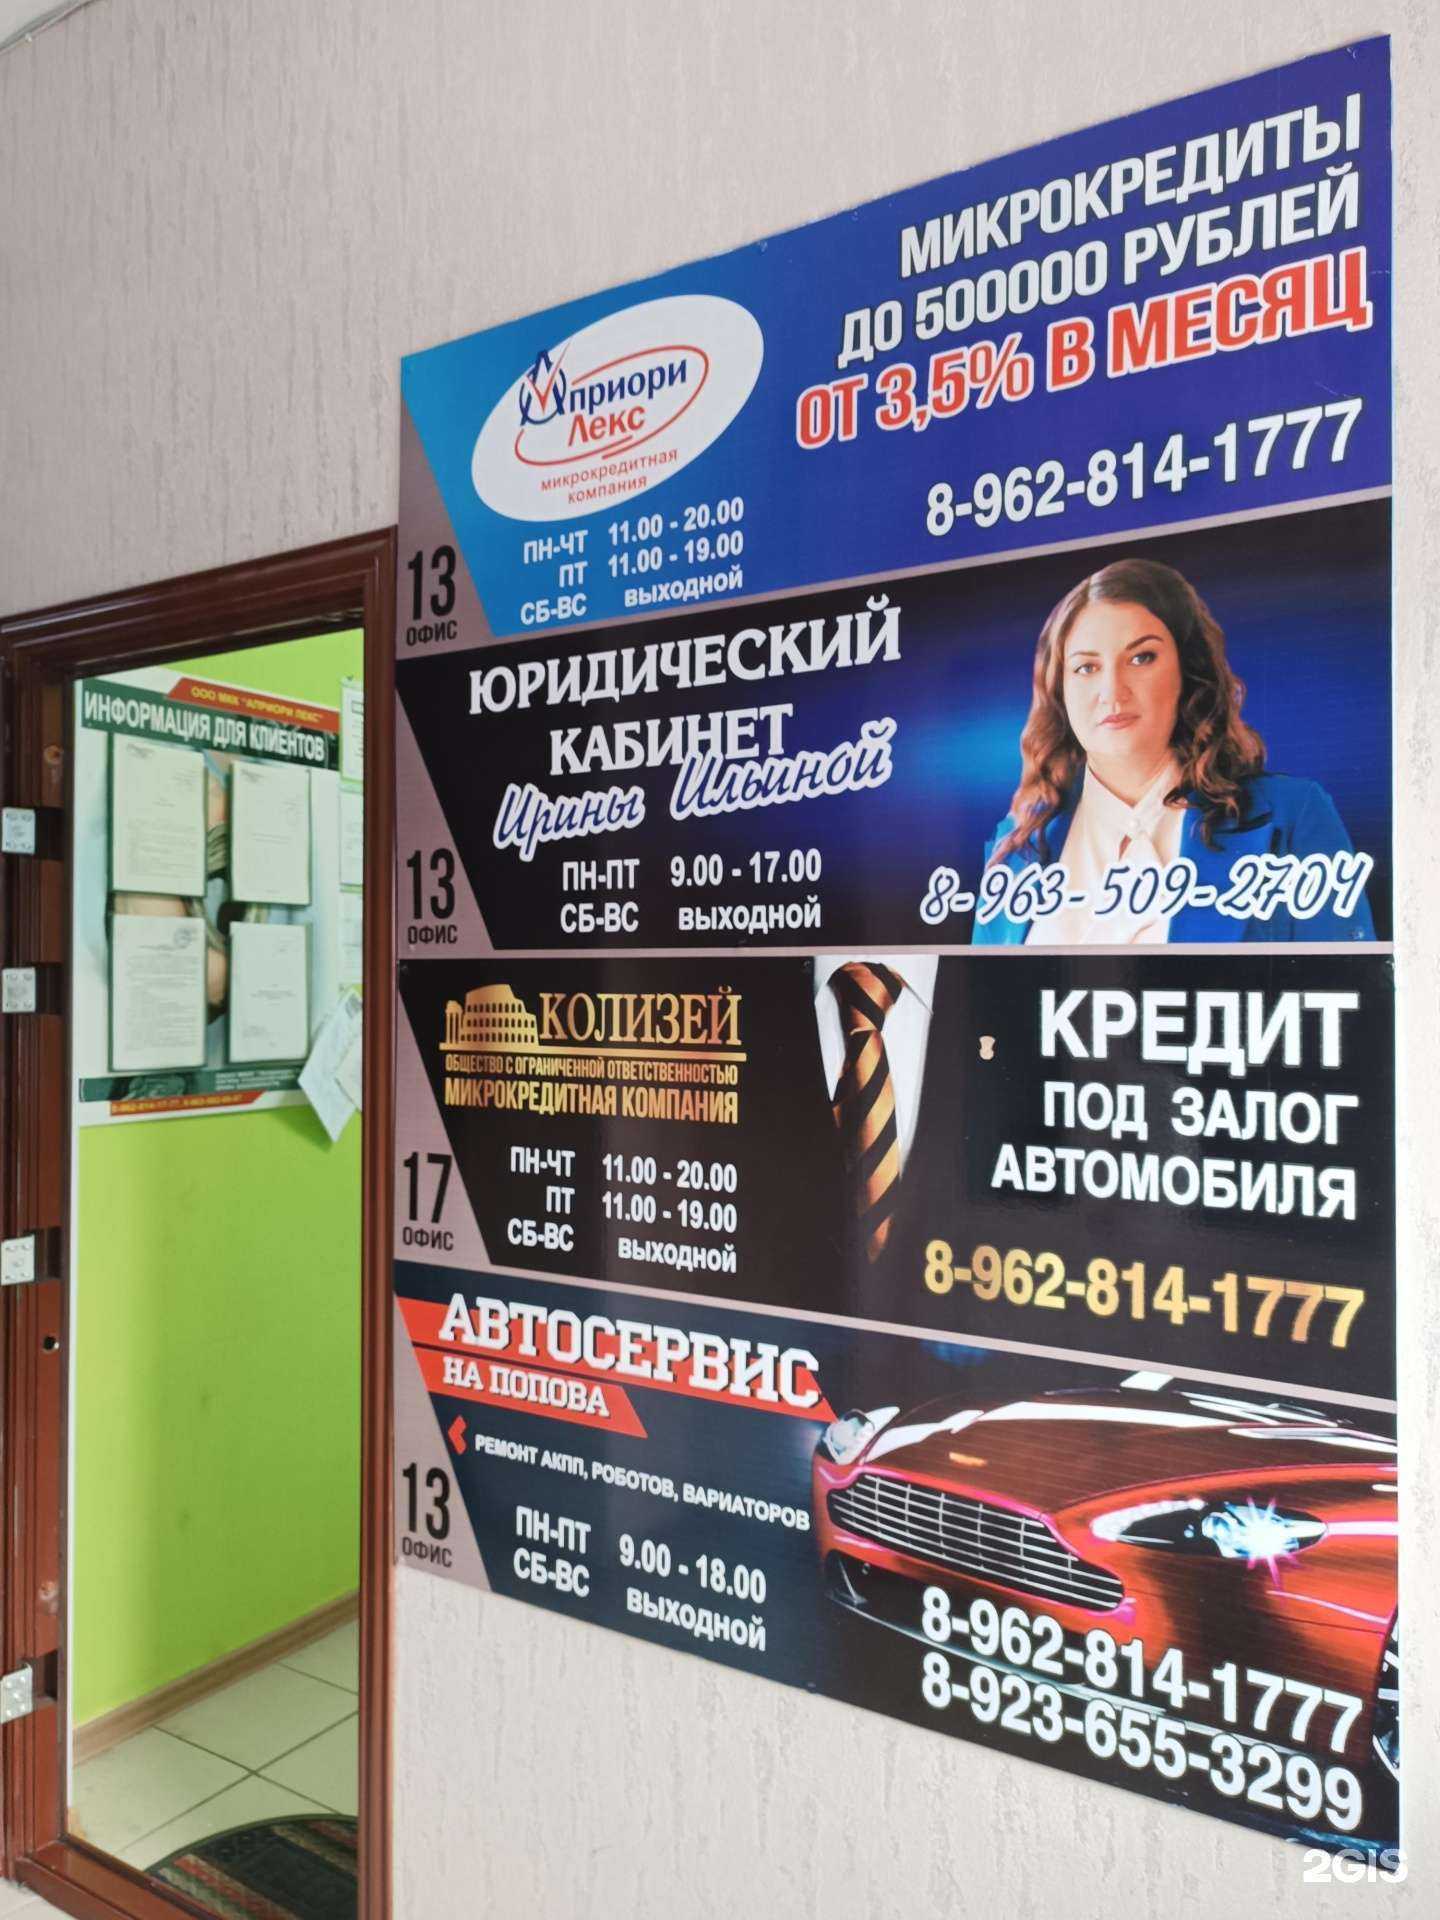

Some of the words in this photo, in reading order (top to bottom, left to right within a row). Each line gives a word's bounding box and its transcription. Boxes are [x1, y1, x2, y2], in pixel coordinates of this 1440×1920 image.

[900, 93, 1361, 278] МИКРОКРЕДИТЫ
[838, 301, 902, 368] ДО
[915, 240, 1107, 341] 500000
[1125, 162, 1360, 285] РУБЛЕЙ
[796, 373, 868, 450] ОТ
[876, 334, 1033, 431] 3,5%
[1046, 316, 1094, 392] В
[1107, 246, 1373, 378] МЕСЯЦ
[568, 405, 646, 446] Лекс
[541, 449, 679, 491] микрокредитная
[568, 476, 647, 504] компания
[926, 399, 1363, 537] 8-962-814-1777
[523, 530, 588, 564] ПН-ЧТ
[608, 514, 663, 546] 11.00
[683, 496, 745, 532] 20.00
[559, 562, 588, 588] ПТ
[608, 547, 663, 578] 11.00
[684, 530, 744, 564] 19.00
[407, 545, 456, 621] 13
[520, 594, 587, 625] СБ-ВС
[406, 621, 457, 646] ОФИС
[468, 594, 901, 715] ЮРИДИЧЕСКИЙ
[84, 690, 211, 742] ИНФОРМАЦИЯ
[213, 716, 246, 749] ДЛЯ
[250, 724, 326, 762] КЛИЕНТОВ
[550, 704, 793, 776] КАБИНЕТ
[493, 783, 645, 861] Ирины
[670, 717, 897, 820] Ильиной
[407, 847, 456, 920] 13
[563, 859, 639, 891] ПН-ПТ
[670, 854, 723, 887] 9.00
[749, 848, 821, 883] 17.00
[407, 924, 457, 944] ОФИС
[560, 901, 639, 933] СБ-ВС
[538, 985, 742, 1046] КОЛИЗЕЙ
[1041, 989, 1360, 1077] КРЕДИТ
[445, 1053, 504, 1074] ОБЩЕСТВО
[505, 1059, 514, 1074] С
[515, 1057, 605, 1078] ОГРАНИЧЕННОЙ
[607, 1060, 738, 1085] ОТВЕТСТВЕННОСТЬЮ
[445, 1077, 616, 1116] МИКРОКРЕДИТНАЯ
[622, 1086, 738, 1125] КОМПАНИЯ
[1044, 1081, 1148, 1141] ПОД
[1172, 1086, 1359, 1145] ЗАЛОГ
[403, 1151, 452, 1224] 17
[510, 1145, 575, 1178] ПН-ЧТ
[602, 1153, 657, 1186] 11.00
[677, 1160, 737, 1193] 20.00
[991, 1143, 1356, 1220] АВТОМОБИЛЯ
[402, 1226, 454, 1251] ОФИС
[508, 1218, 574, 1253] СБ-ВС
[546, 1185, 575, 1215] ПТ
[602, 1191, 657, 1224] 11.00
[677, 1199, 737, 1234] 19.00
[924, 1239, 1365, 1349] 8-962-814-1777
[438, 1293, 819, 1409] АВТОСЕРВИС
[443, 1355, 484, 1391] НА
[489, 1367, 609, 1418] ПОПОВА
[403, 1461, 450, 1541] 13
[475, 1434, 539, 1465] РЕМОНТ
[541, 1450, 588, 1480] АКПП,
[591, 1461, 678, 1502] РОБОТОВ,
[683, 1483, 811, 1531] ВАРИАТОРОВ
[402, 1536, 453, 1569] ОФИС
[513, 1548, 590, 1598] СБ-ВС
[516, 1505, 591, 1555] ПН-ПТ
[619, 1533, 671, 1578] 9.00
[696, 1554, 767, 1603] 18.00
[921, 1586, 1363, 1755] 8-962-814-1777
[922, 1652, 1363, 1831] 8-923-655-3299
